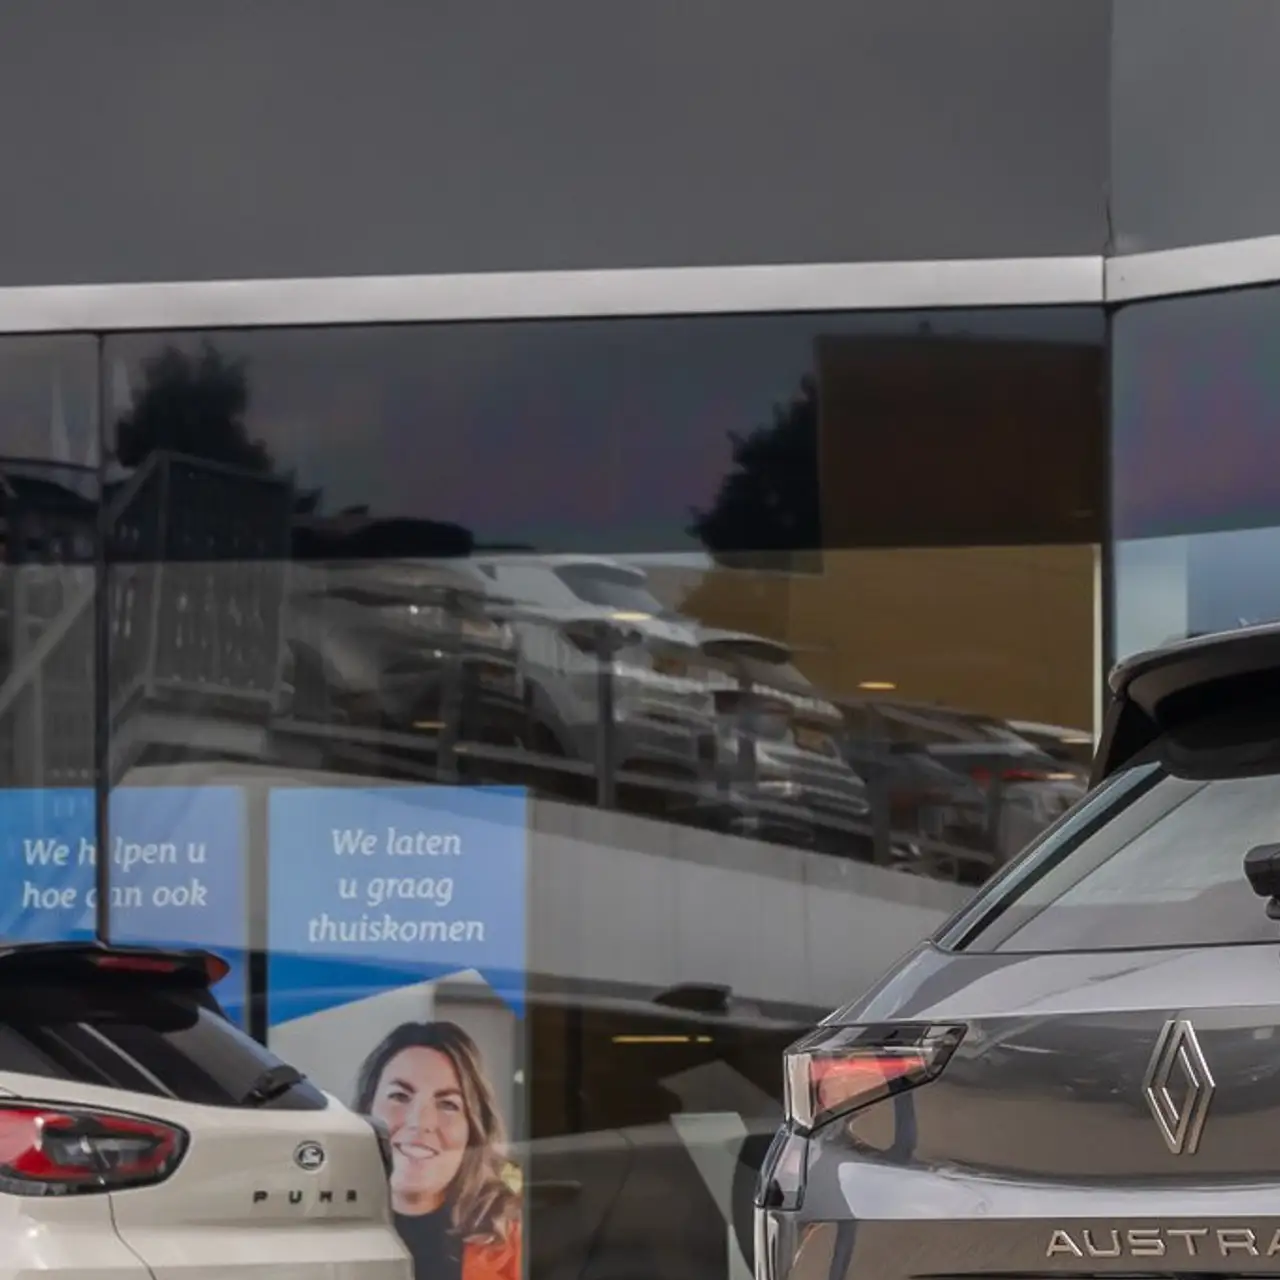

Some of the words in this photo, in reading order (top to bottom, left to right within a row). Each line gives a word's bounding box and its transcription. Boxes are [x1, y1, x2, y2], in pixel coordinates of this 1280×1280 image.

[23, 839, 70, 866] We
[78, 836, 177, 873] hlpen
[188, 842, 206, 864] u
[332, 828, 378, 856] We
[386, 826, 462, 856] laten
[23, 880, 77, 909] hoe
[152, 878, 207, 907] ook
[338, 877, 358, 899] u
[367, 876, 453, 907] graag
[308, 912, 485, 942] thuiskomen
